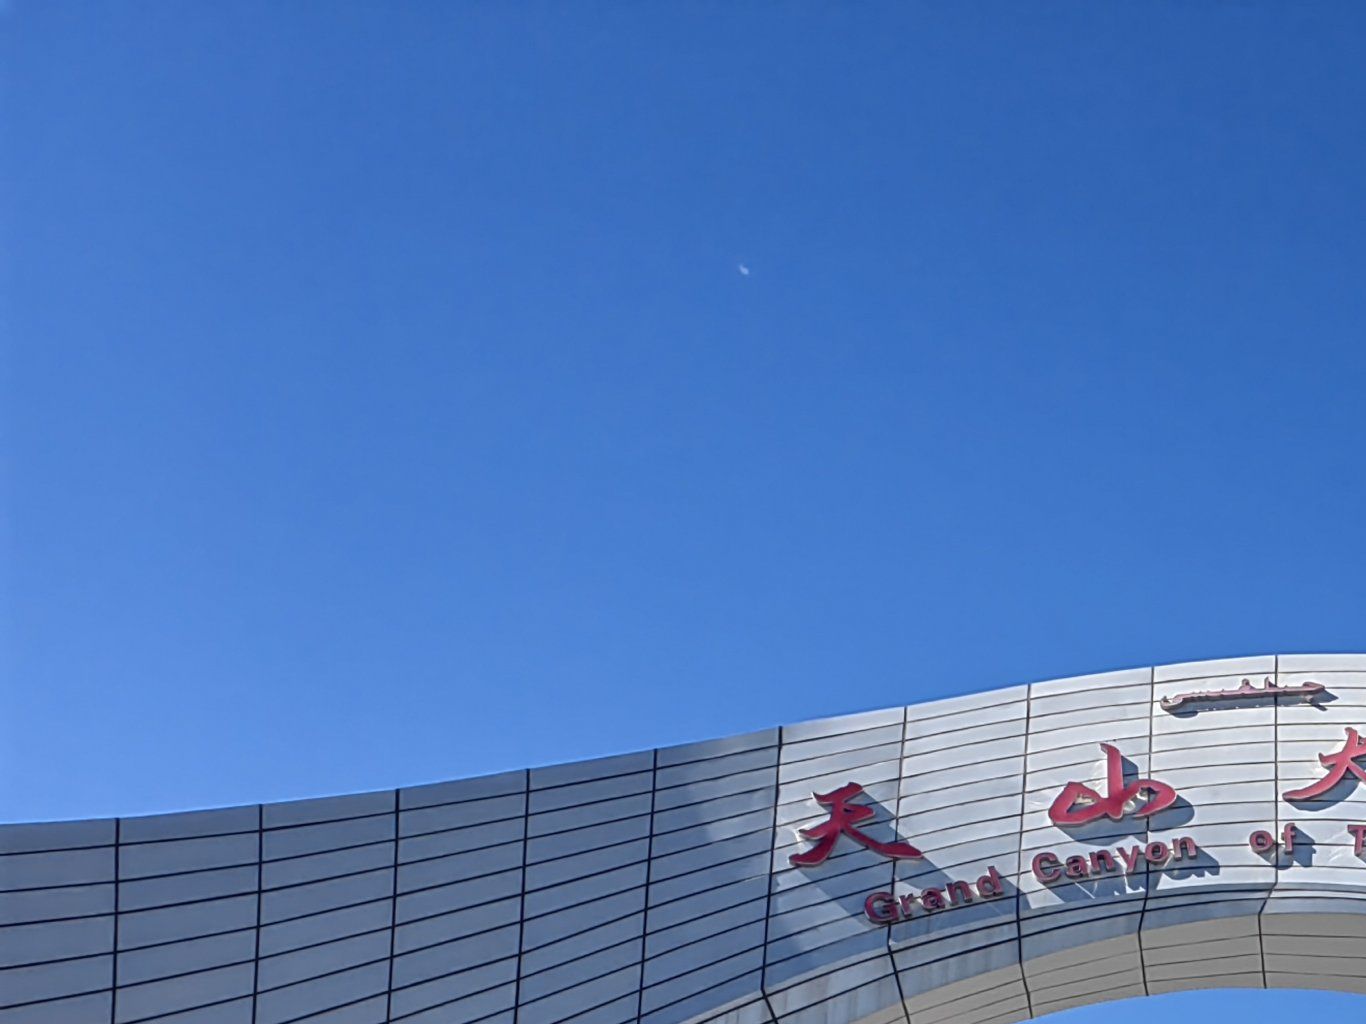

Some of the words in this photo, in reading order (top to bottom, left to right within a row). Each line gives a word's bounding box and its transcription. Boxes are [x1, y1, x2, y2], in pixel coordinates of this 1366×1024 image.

[864, 866, 1003, 924] Grand
[1032, 835, 1197, 884] Canyon
[1249, 822, 1296, 855] of
